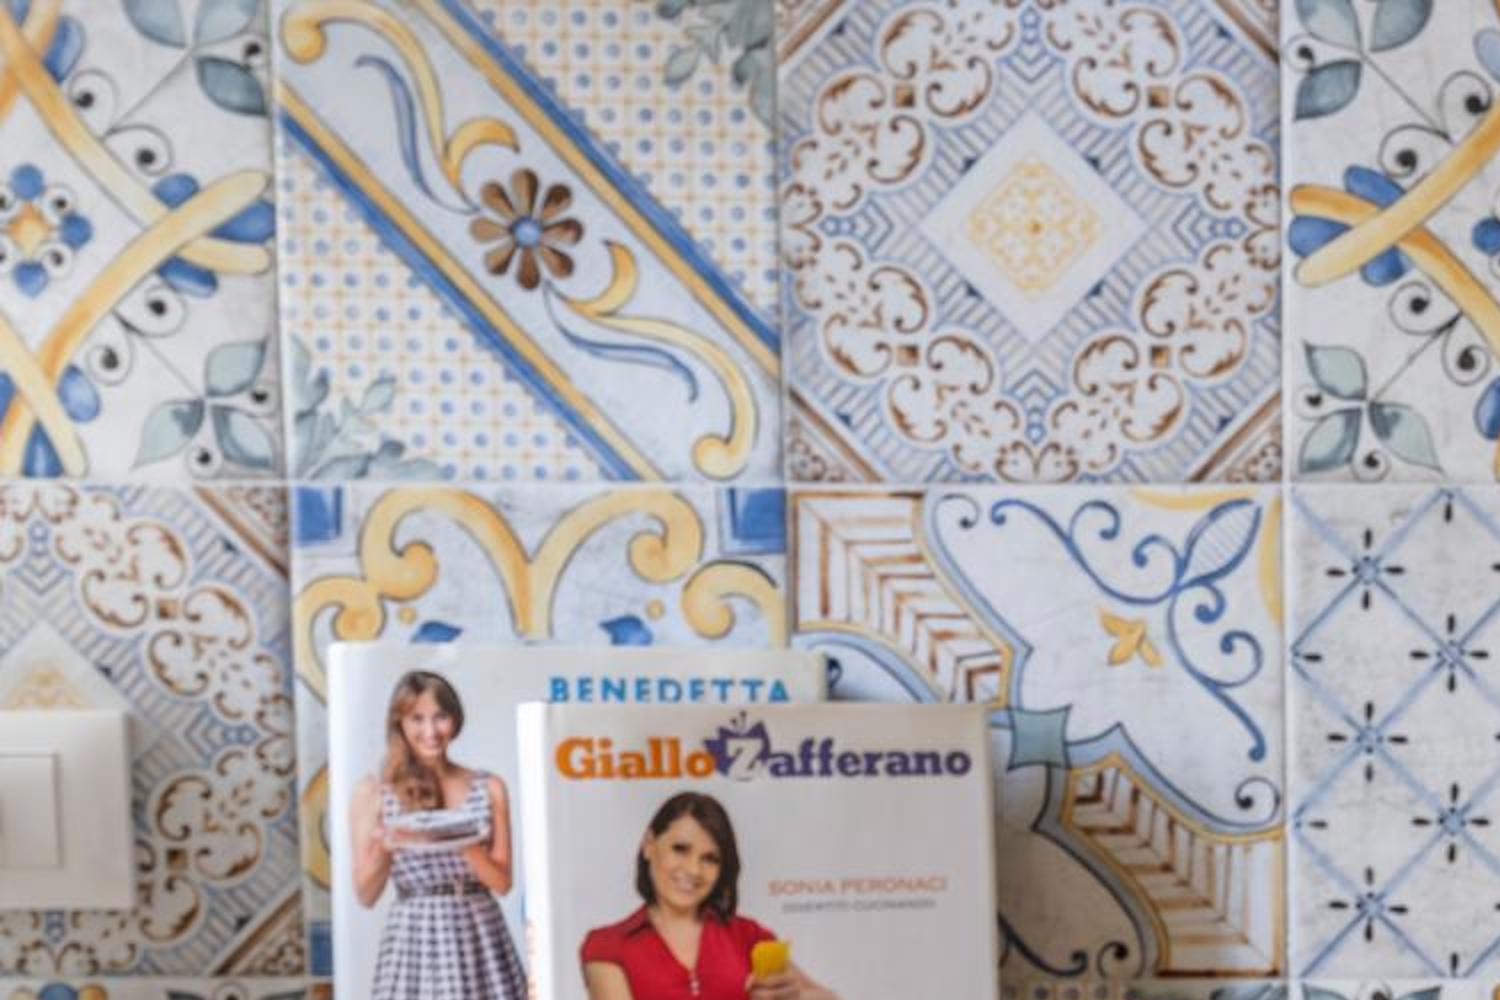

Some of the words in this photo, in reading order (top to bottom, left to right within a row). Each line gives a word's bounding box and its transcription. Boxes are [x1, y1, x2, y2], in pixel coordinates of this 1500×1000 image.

[549, 677, 790, 702] BENEDETTA
[767, 879, 835, 897] SONIA
[841, 875, 947, 895] PERONACI
